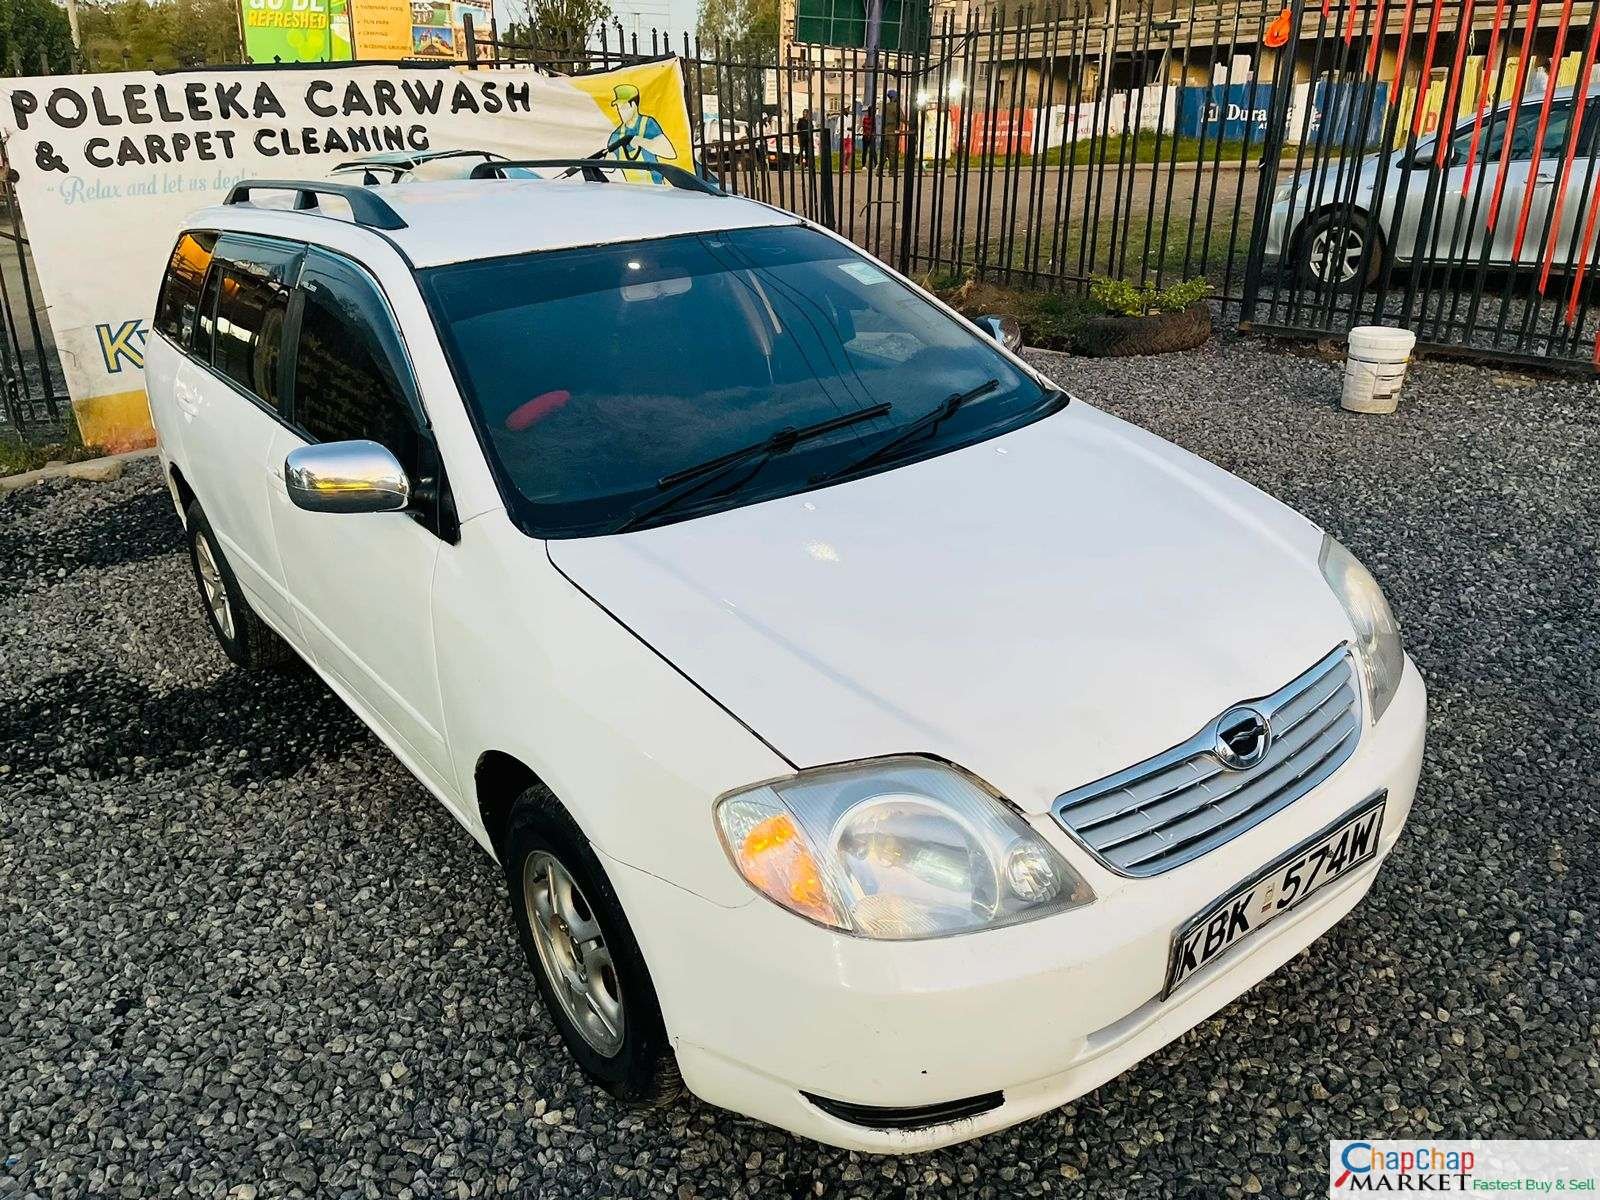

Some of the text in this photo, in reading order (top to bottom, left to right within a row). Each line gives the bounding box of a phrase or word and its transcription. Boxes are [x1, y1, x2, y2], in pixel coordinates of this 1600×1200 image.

[248, 10, 327, 29] REFRESHED
[10, 79, 531, 130] POLELEKA CARWASH
[35, 124, 430, 173] & CARPET CLEANING
[127, 175, 157, 196] and
[163, 173, 183, 194] let
[189, 178, 207, 192] us
[1176, 891, 1255, 982] KBK
[1276, 812, 1377, 910] 574W
